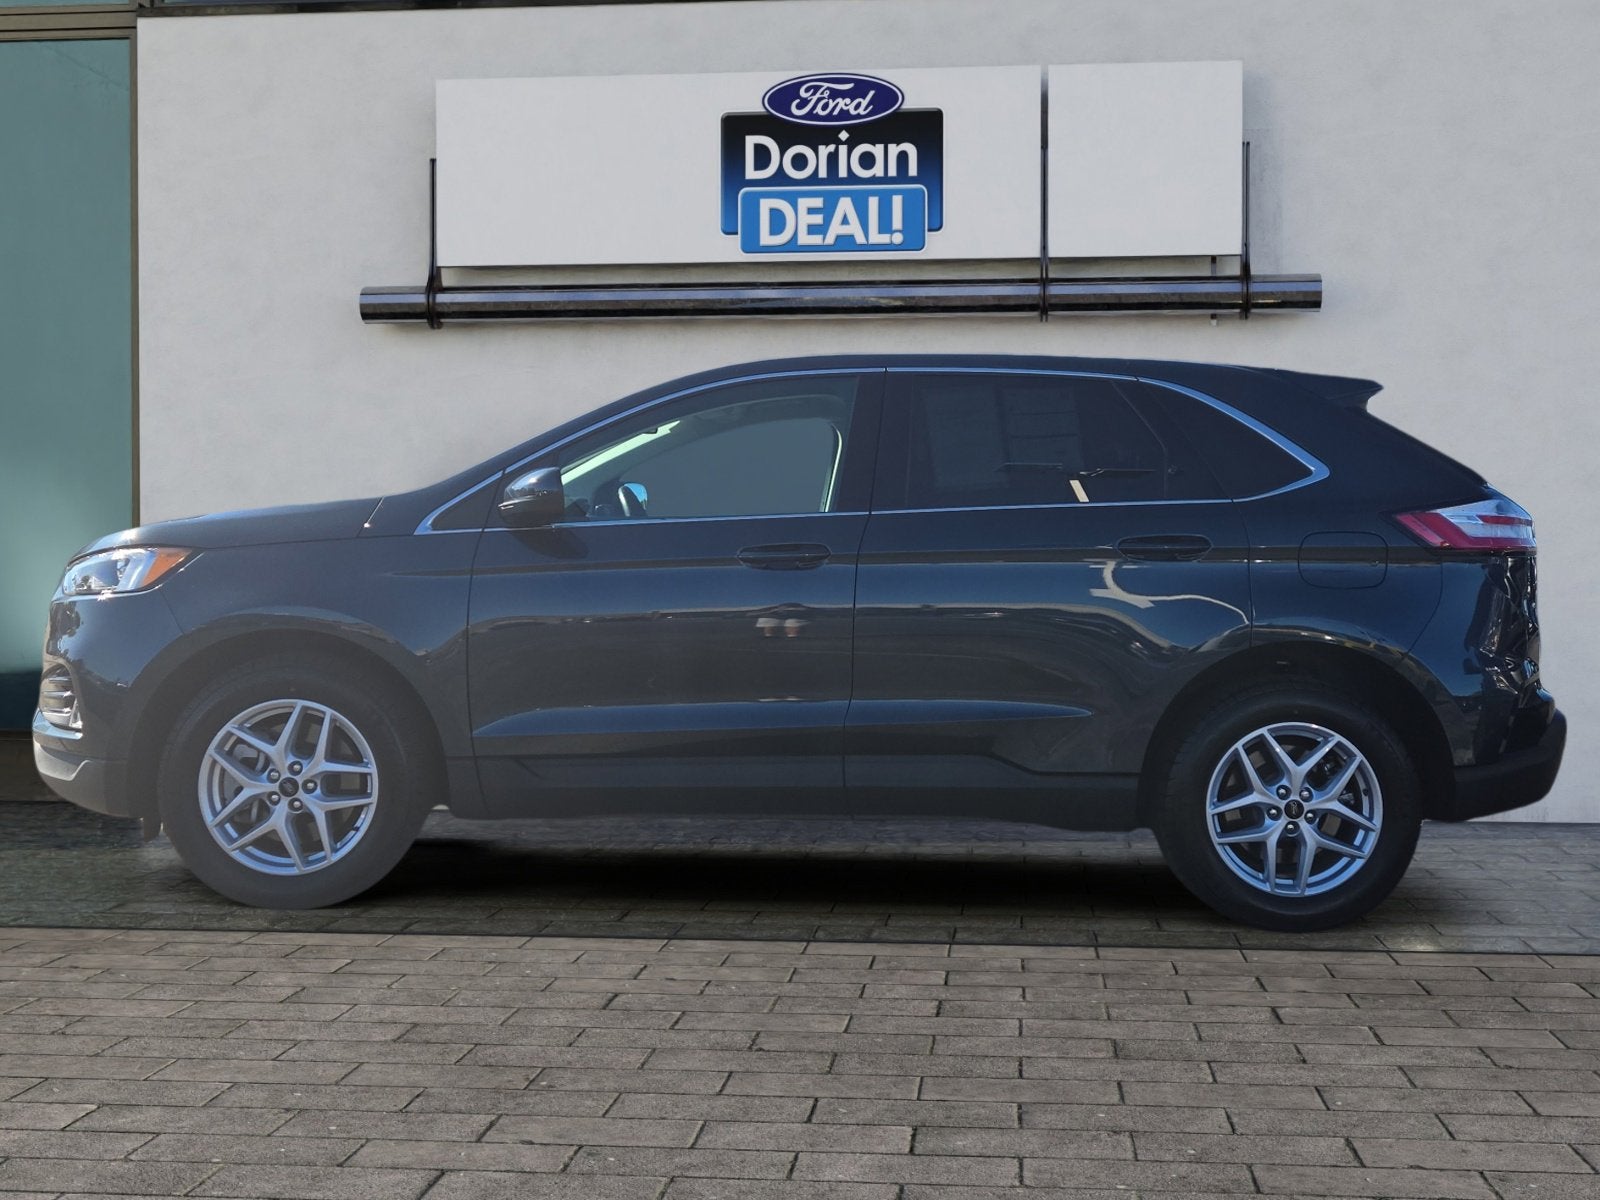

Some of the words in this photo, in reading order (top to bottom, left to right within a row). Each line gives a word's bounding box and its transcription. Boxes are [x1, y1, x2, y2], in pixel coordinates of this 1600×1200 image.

[791, 81, 875, 116] Ford
[745, 129, 918, 180] Dorian
[759, 194, 904, 247] DEAL!
